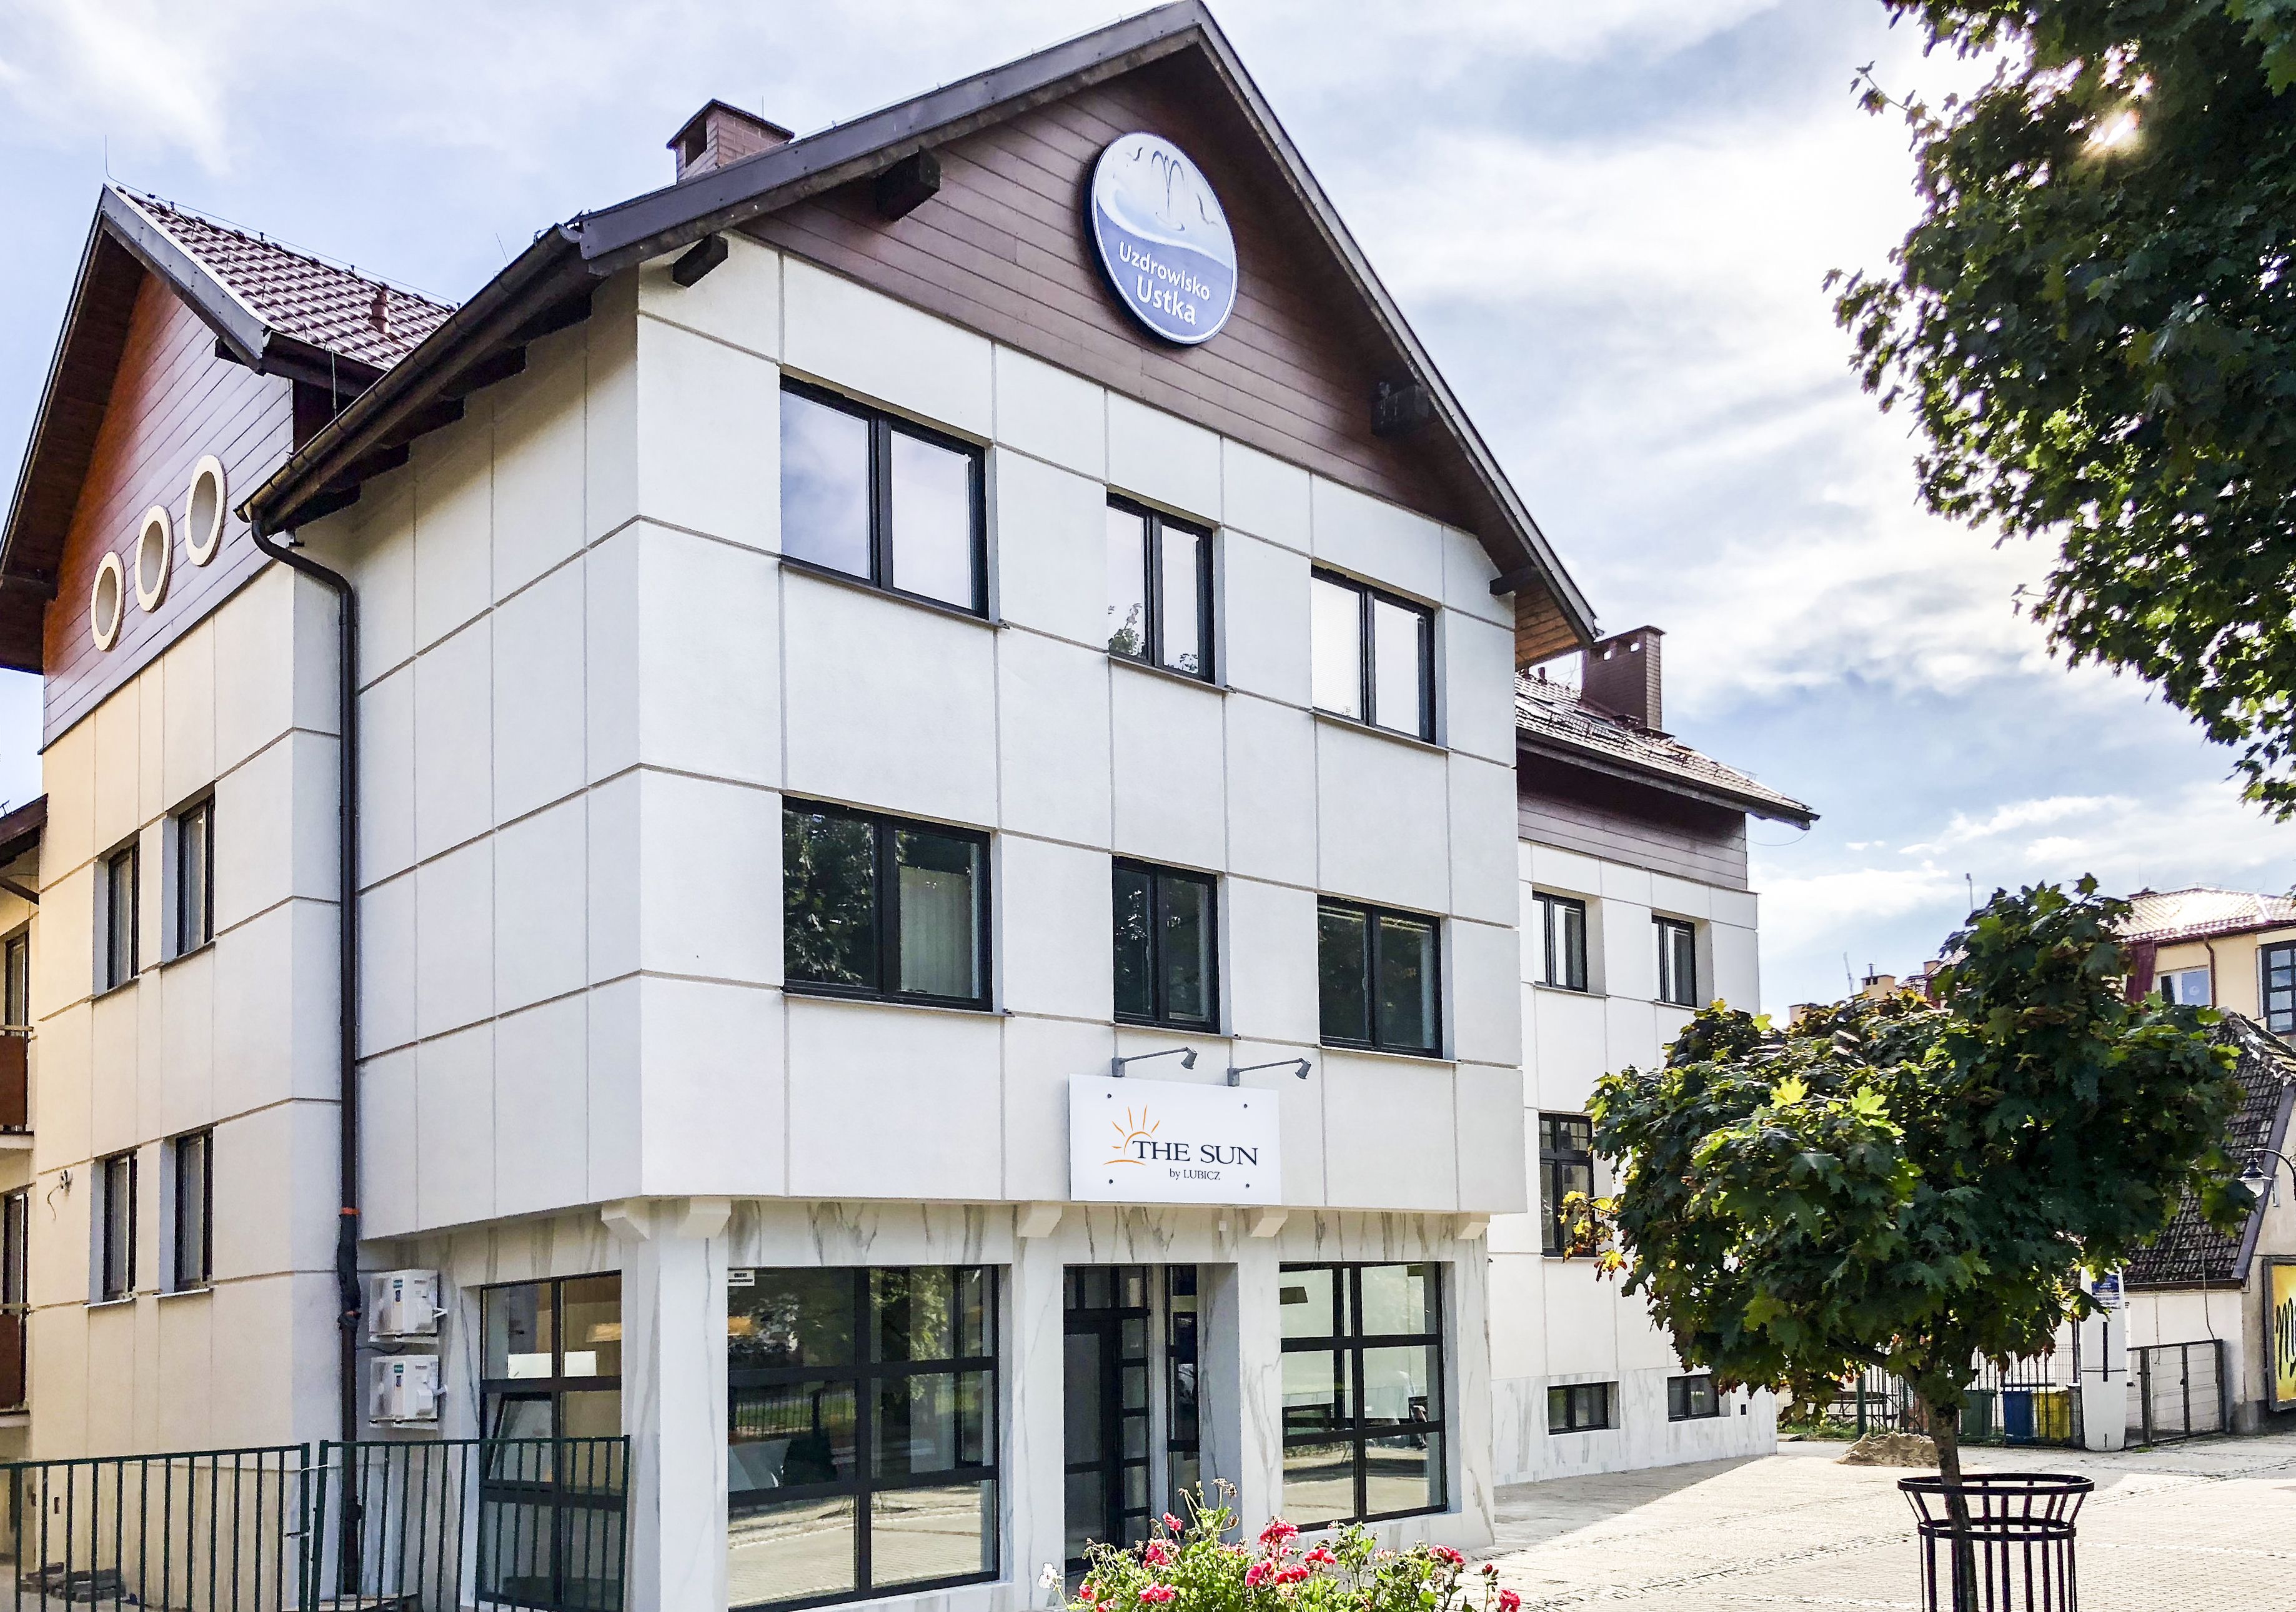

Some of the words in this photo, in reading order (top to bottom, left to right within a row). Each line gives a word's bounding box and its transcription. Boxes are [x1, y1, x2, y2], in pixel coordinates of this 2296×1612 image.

[1119, 241, 1210, 301] Uzdrowisko
[1136, 275, 1196, 326] Ustka
[1132, 1140, 1190, 1162] THE
[1200, 1144, 1258, 1166] SUN
[1170, 1168, 1181, 1180] by
[1183, 1170, 1221, 1180] LUBICZ
